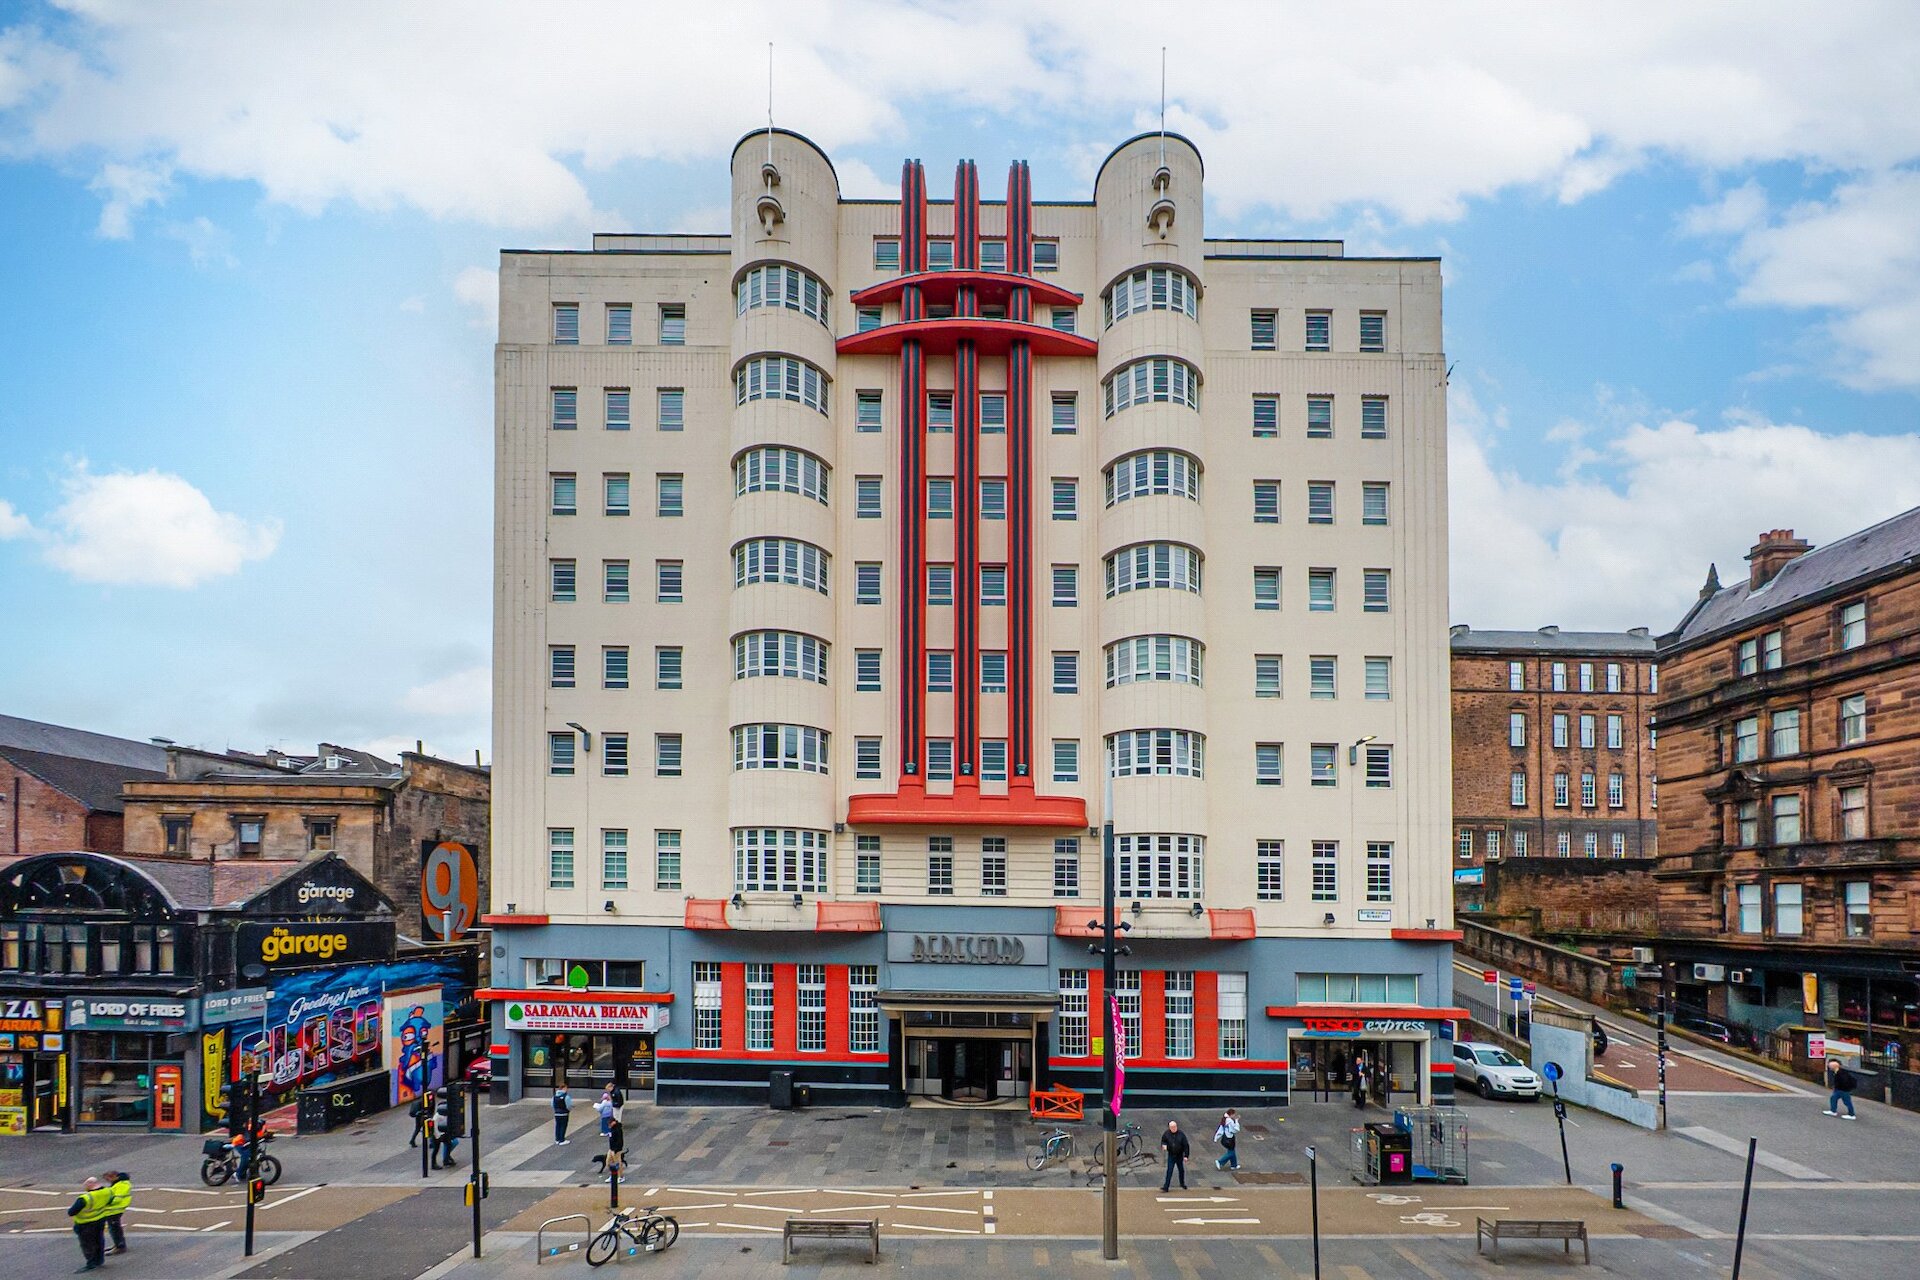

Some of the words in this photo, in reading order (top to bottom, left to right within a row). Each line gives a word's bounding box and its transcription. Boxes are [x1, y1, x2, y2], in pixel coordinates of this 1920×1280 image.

[298, 885, 355, 903] garage
[273, 927, 289, 936] the
[262, 933, 347, 961] garage
[911, 934, 1026, 965] BERESFORD
[205, 997, 229, 1009] LORD
[231, 996, 242, 1005] OF
[243, 993, 265, 1004] FRIES
[287, 991, 346, 1024] Greetings
[345, 986, 370, 1002] from
[90, 1002, 127, 1017] LORD
[129, 1003, 149, 1017] OF
[149, 1003, 185, 1018] FRIES
[524, 1004, 596, 1018] SARAVANAA
[600, 1005, 648, 1019] BHAVAN
[1303, 1018, 1363, 1032] TESCO
[1366, 1019, 1426, 1034] express
